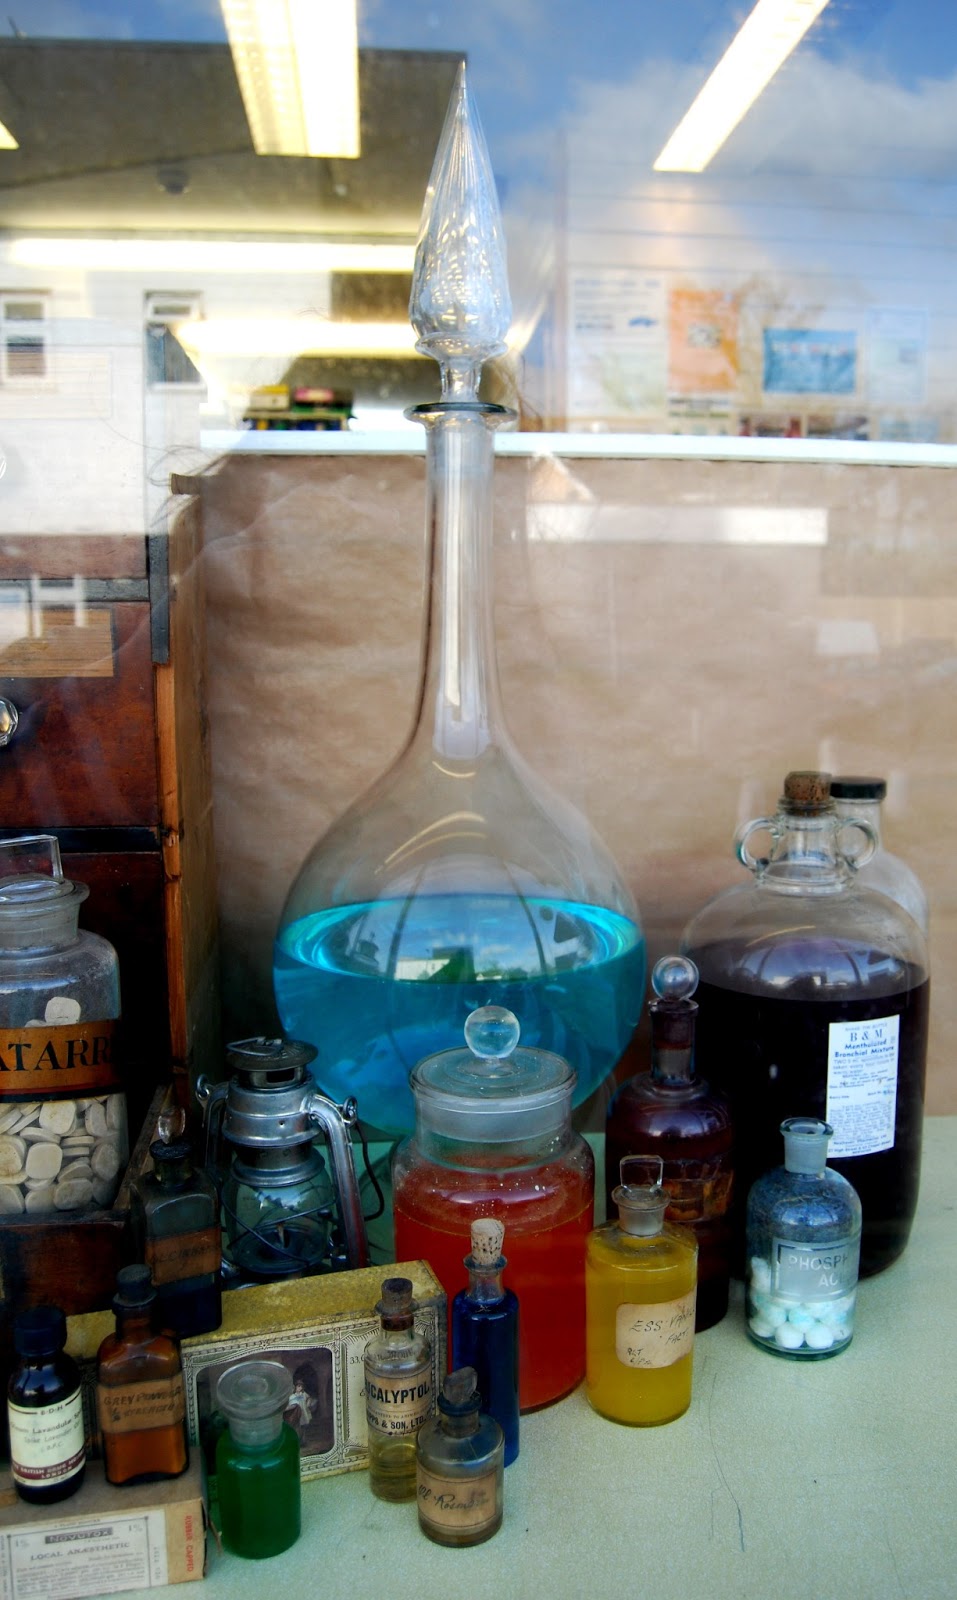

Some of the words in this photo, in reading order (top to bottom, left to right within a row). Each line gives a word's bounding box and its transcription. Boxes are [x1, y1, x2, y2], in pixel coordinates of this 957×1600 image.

[850, 1032, 858, 1042] B
[861, 1030, 869, 1041] &
[875, 1028, 883, 1038] M
[834, 1049, 868, 1058] Bronchial
[870, 1046, 894, 1055] Mixture
[381, 1420, 388, 1429] &
[20, 1467, 44, 1475] BRITISH
[41, 1465, 73, 1479] LONDON
[185, 1515, 193, 1541] RUBBER
[30, 1551, 64, 1562] LOCAL
[185, 1545, 194, 1572] CAPPED
